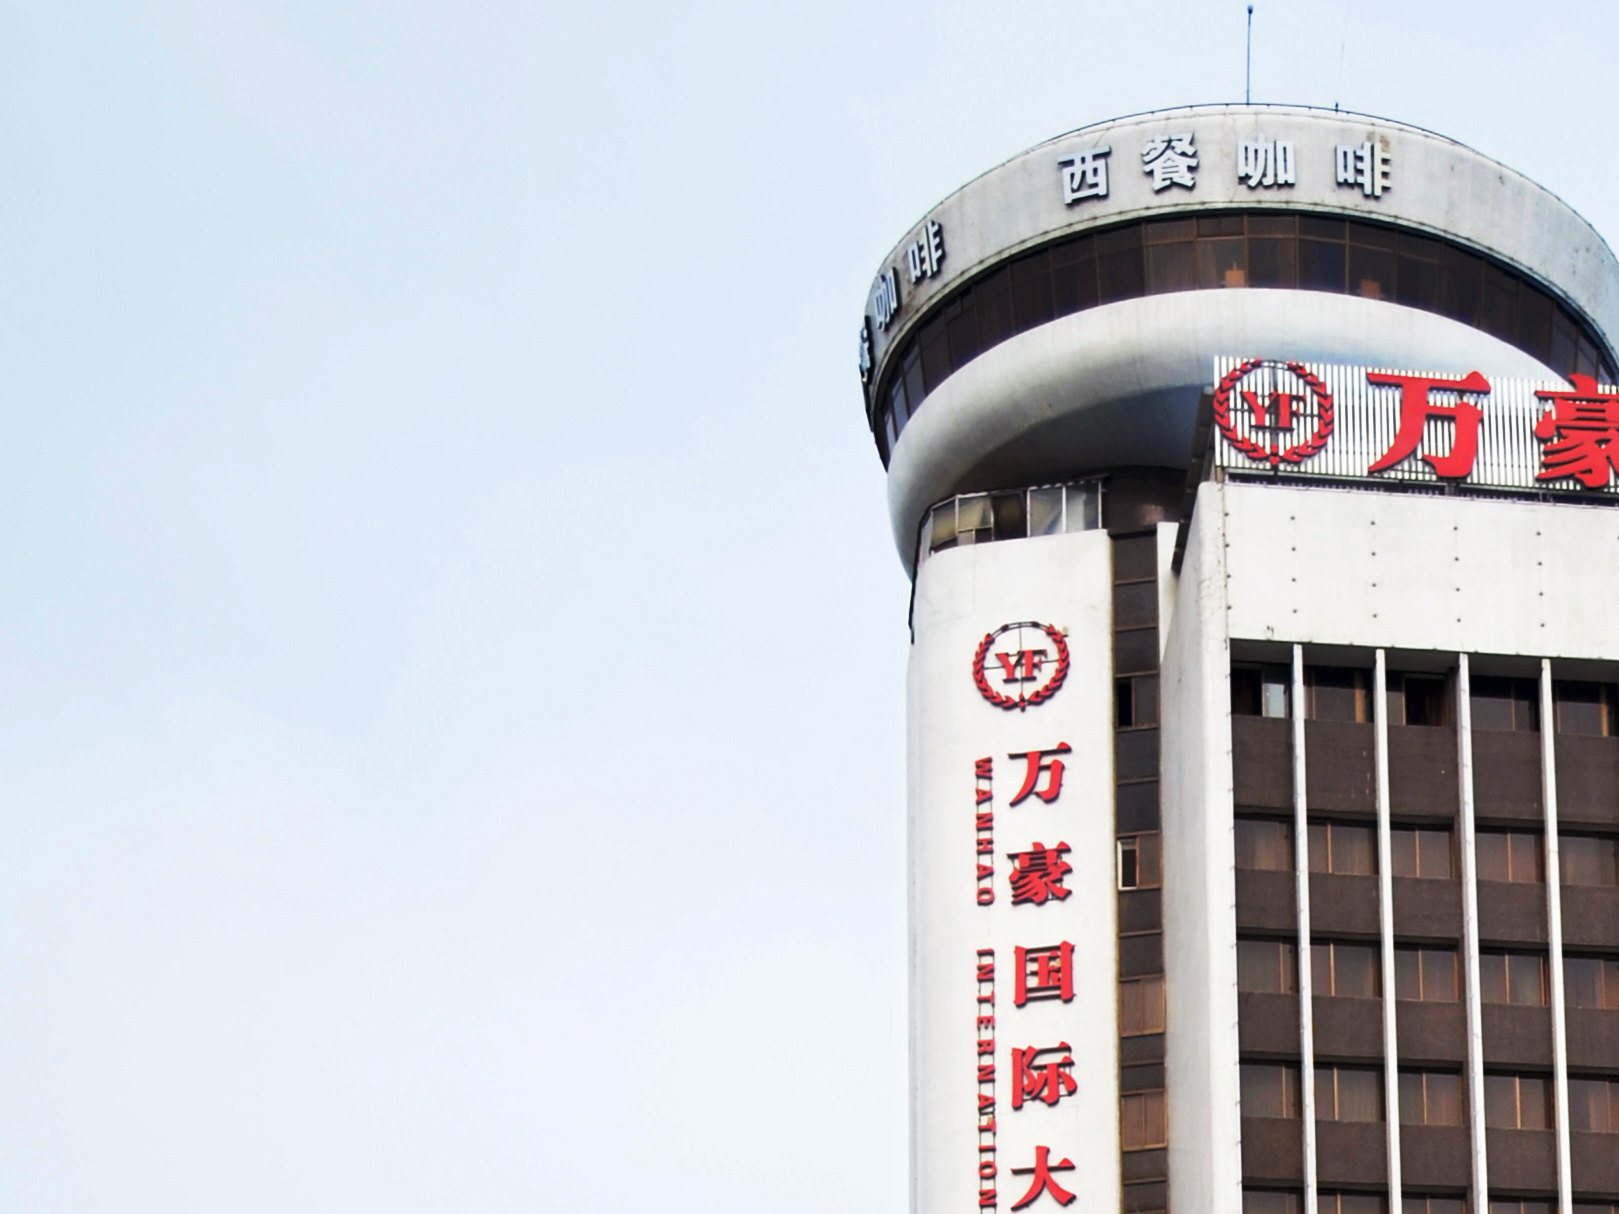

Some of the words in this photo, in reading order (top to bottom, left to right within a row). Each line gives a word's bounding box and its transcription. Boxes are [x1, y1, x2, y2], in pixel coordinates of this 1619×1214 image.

[1057, 131, 1391, 206] 西餐咖啡
[1239, 388, 1307, 431] YF
[995, 649, 1048, 684] YF
[974, 756, 995, 907] WANHAO
